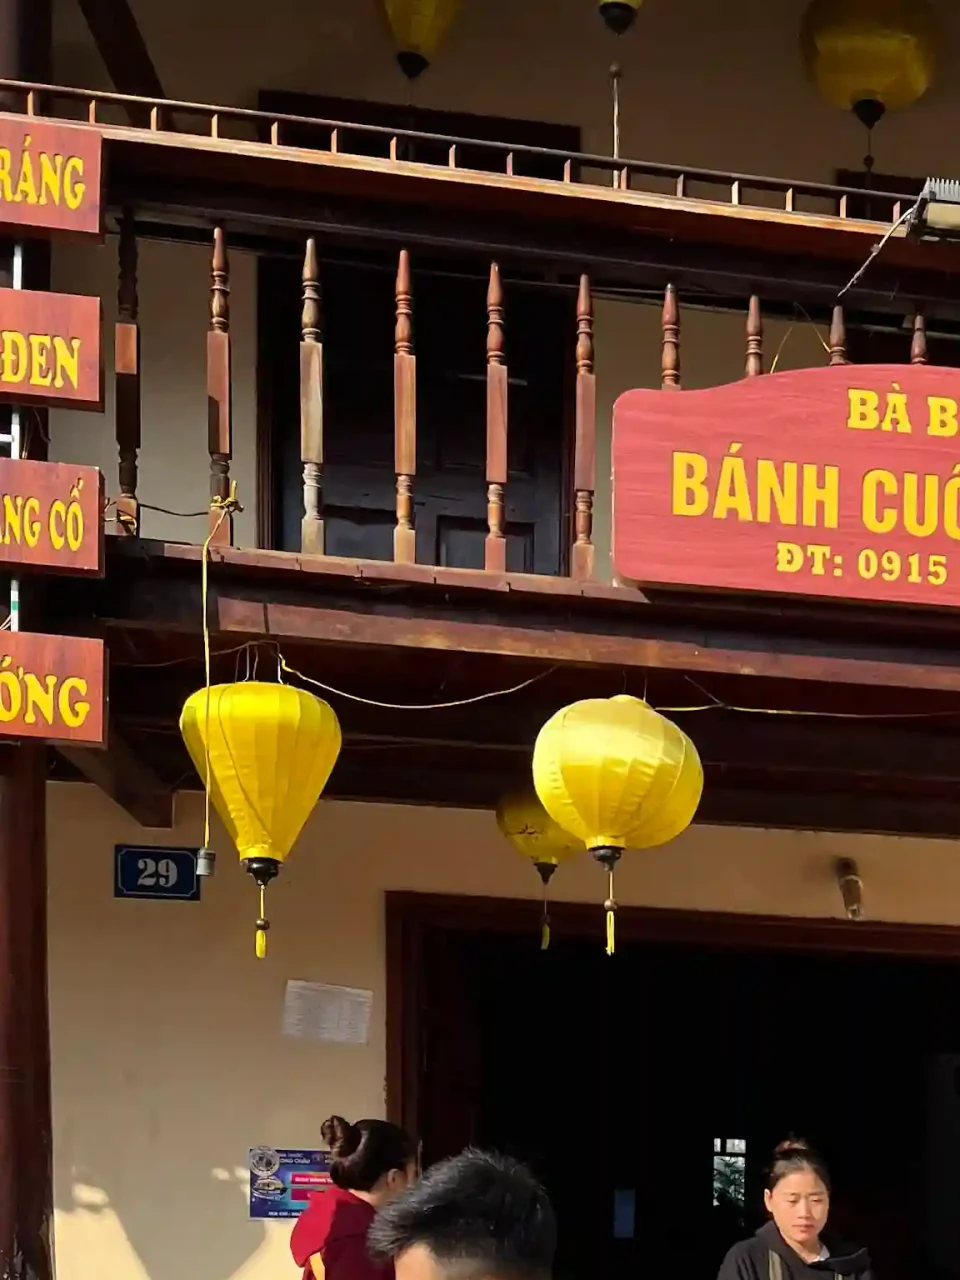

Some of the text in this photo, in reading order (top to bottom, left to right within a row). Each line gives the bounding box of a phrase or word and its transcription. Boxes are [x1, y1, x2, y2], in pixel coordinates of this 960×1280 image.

[0, 331, 80, 390] ĐEN
[847, 381, 912, 434] BÀ
[671, 442, 839, 529] BÁNH
[0, 477, 84, 551] NG CỐ
[775, 541, 844, 578] ĐT:
[857, 552, 948, 586] 0915
[137, 858, 179, 888] 29
